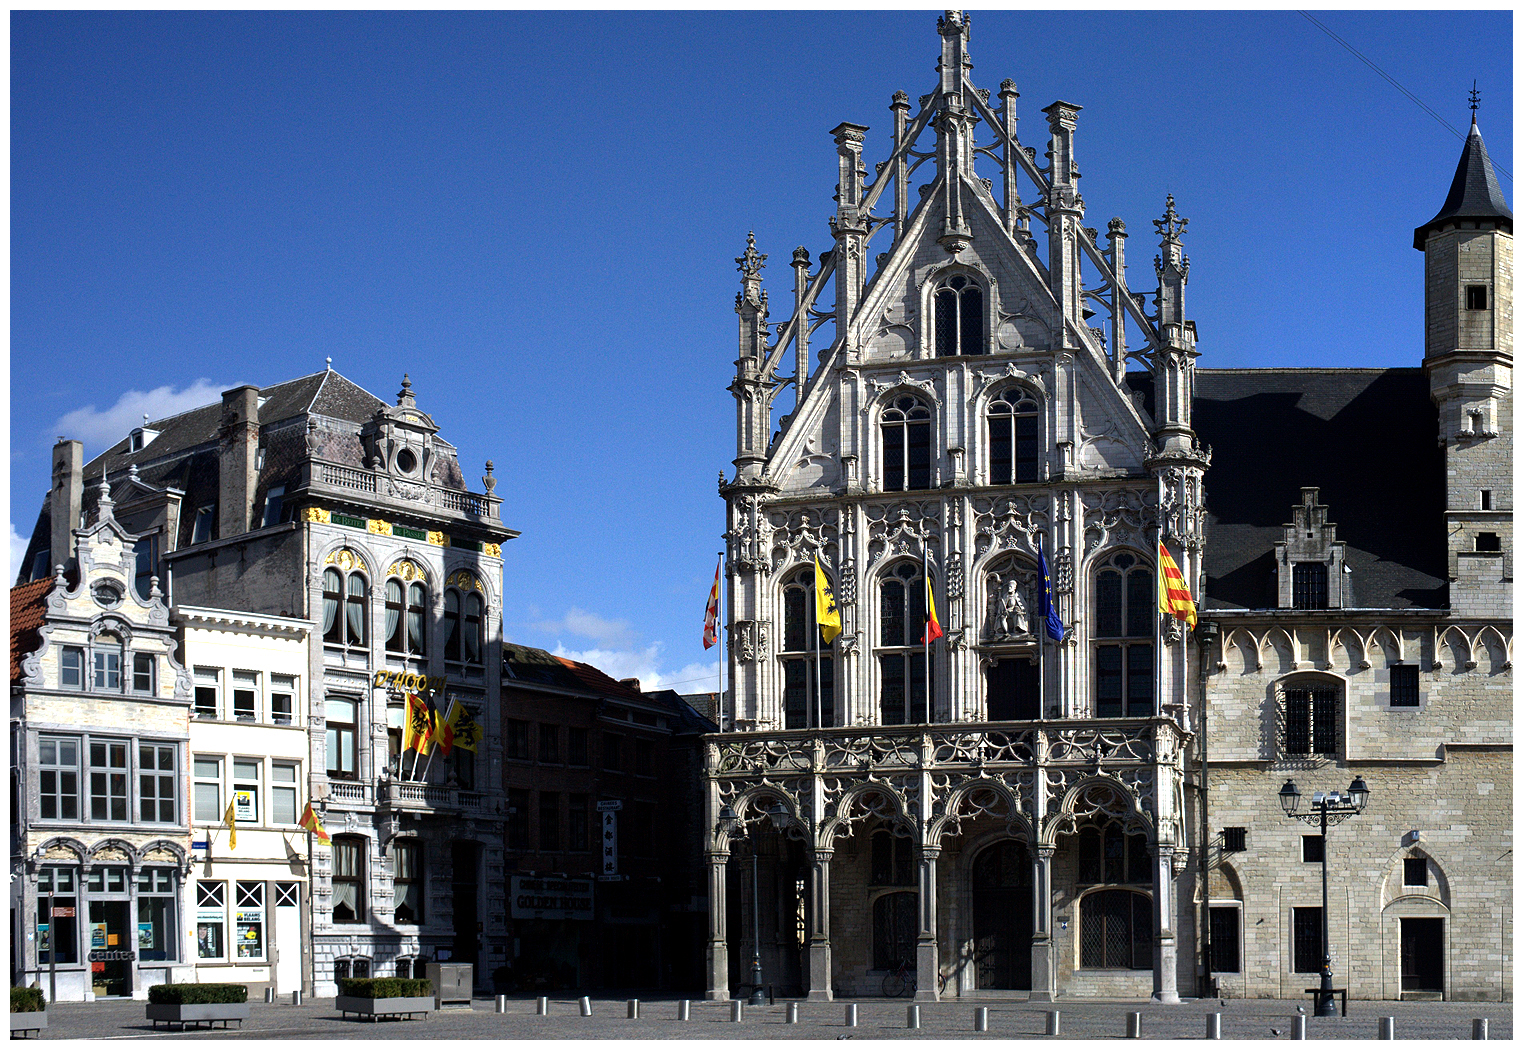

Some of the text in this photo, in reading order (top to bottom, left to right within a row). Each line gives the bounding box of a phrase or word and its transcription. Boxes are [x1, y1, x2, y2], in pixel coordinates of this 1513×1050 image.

[517, 894, 592, 910] GOLDEN HOUSE
[88, 950, 136, 962] centea
